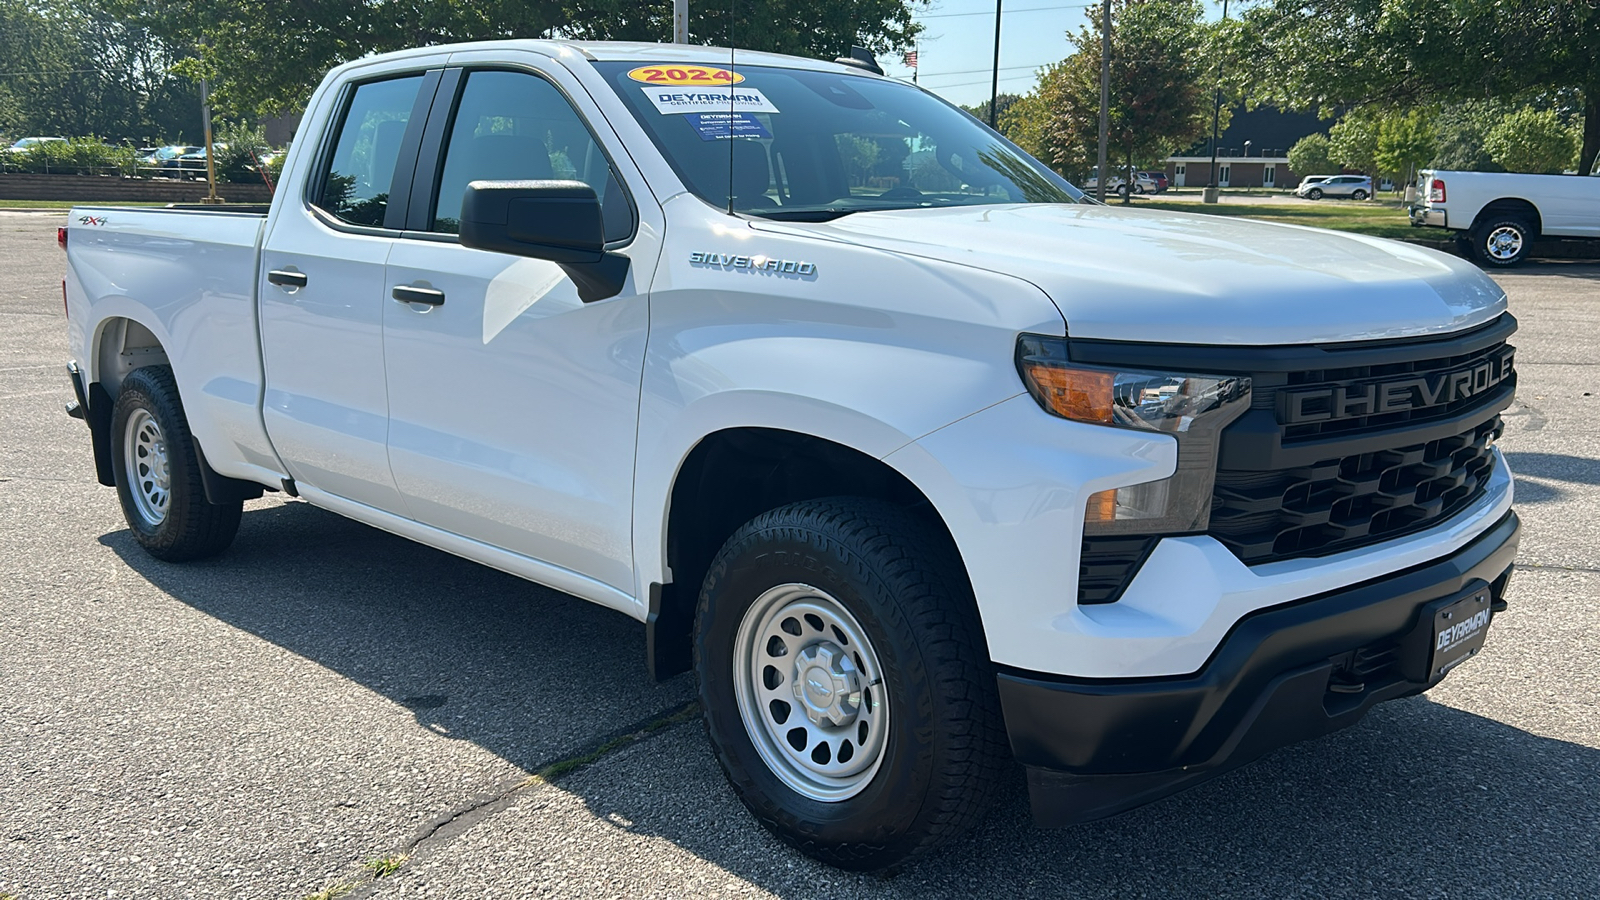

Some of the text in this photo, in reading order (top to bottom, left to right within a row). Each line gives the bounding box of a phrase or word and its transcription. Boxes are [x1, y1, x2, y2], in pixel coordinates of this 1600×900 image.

[643, 69, 732, 81] 2024
[659, 94, 760, 102] DEYARMAN
[689, 251, 817, 276] SILVERADO
[1436, 608, 1489, 651] DEYARMAN
